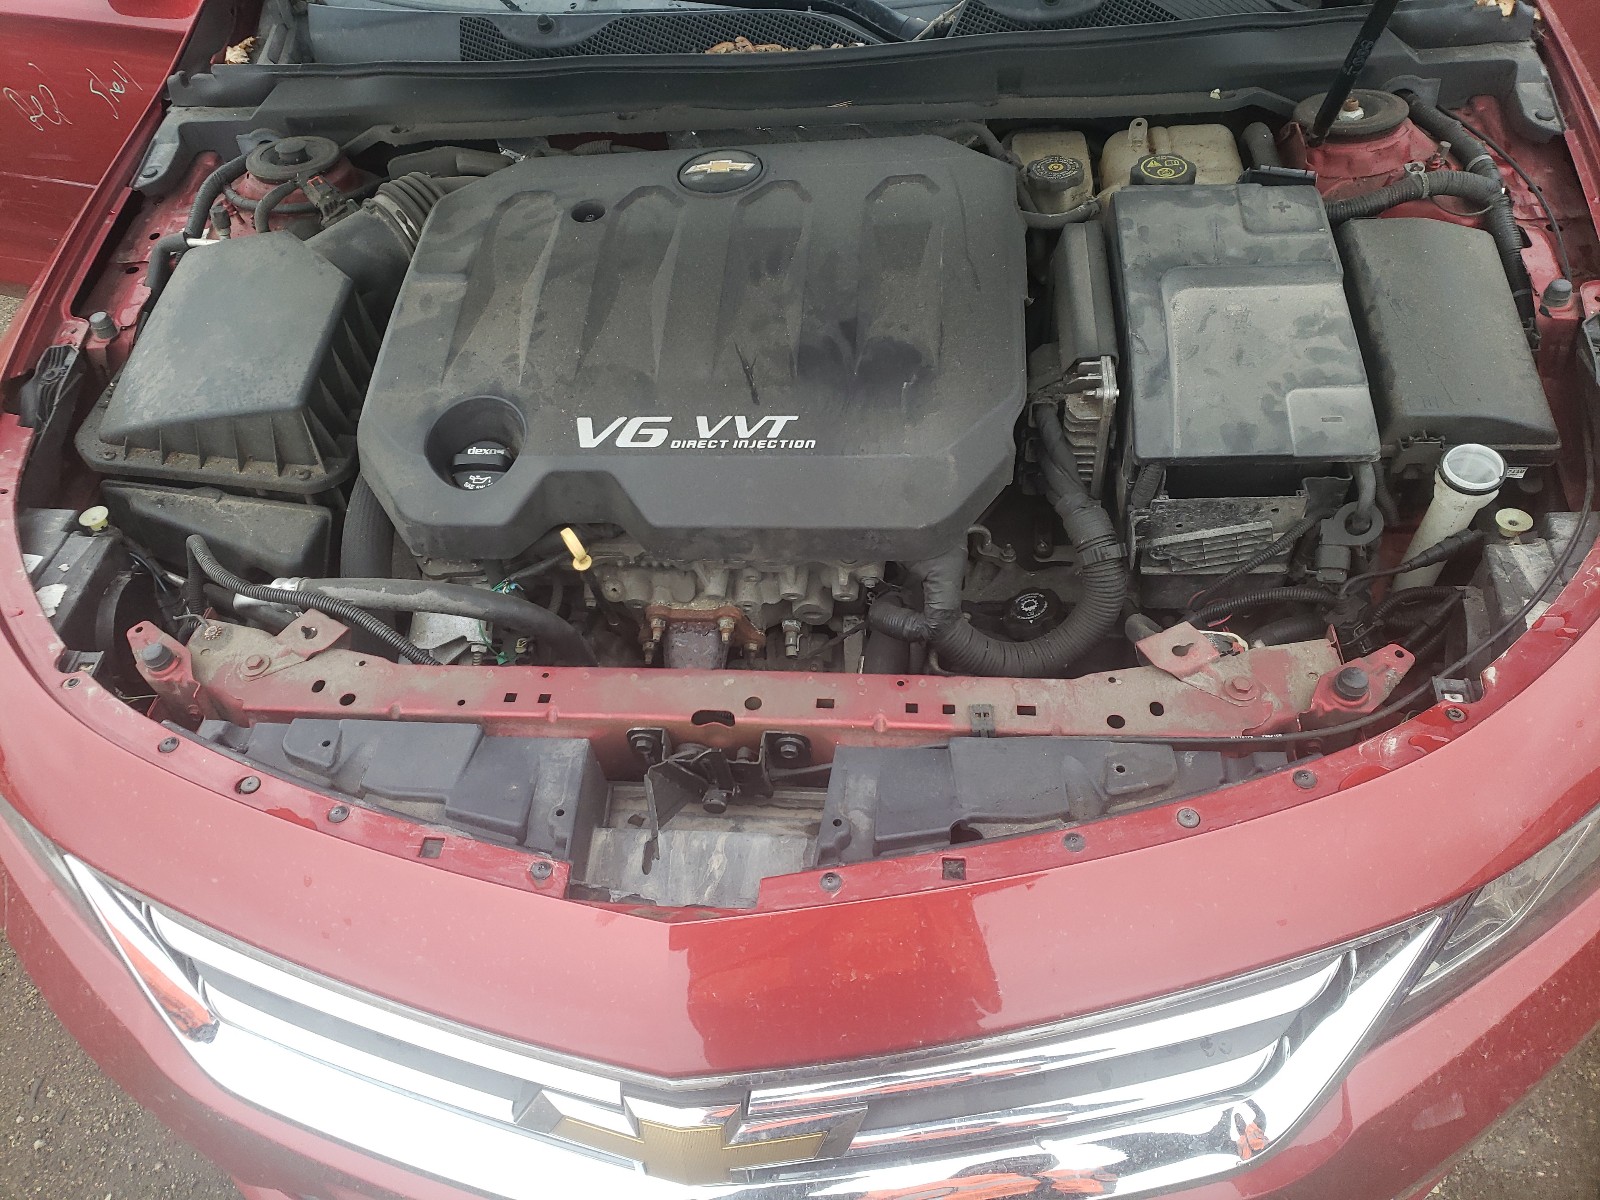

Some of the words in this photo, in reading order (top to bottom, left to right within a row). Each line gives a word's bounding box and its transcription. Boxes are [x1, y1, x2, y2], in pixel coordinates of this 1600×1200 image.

[577, 416, 672, 448] V6
[696, 415, 799, 438] VVT
[670, 439, 729, 449] DIRECT
[733, 439, 816, 449] INJECTION
